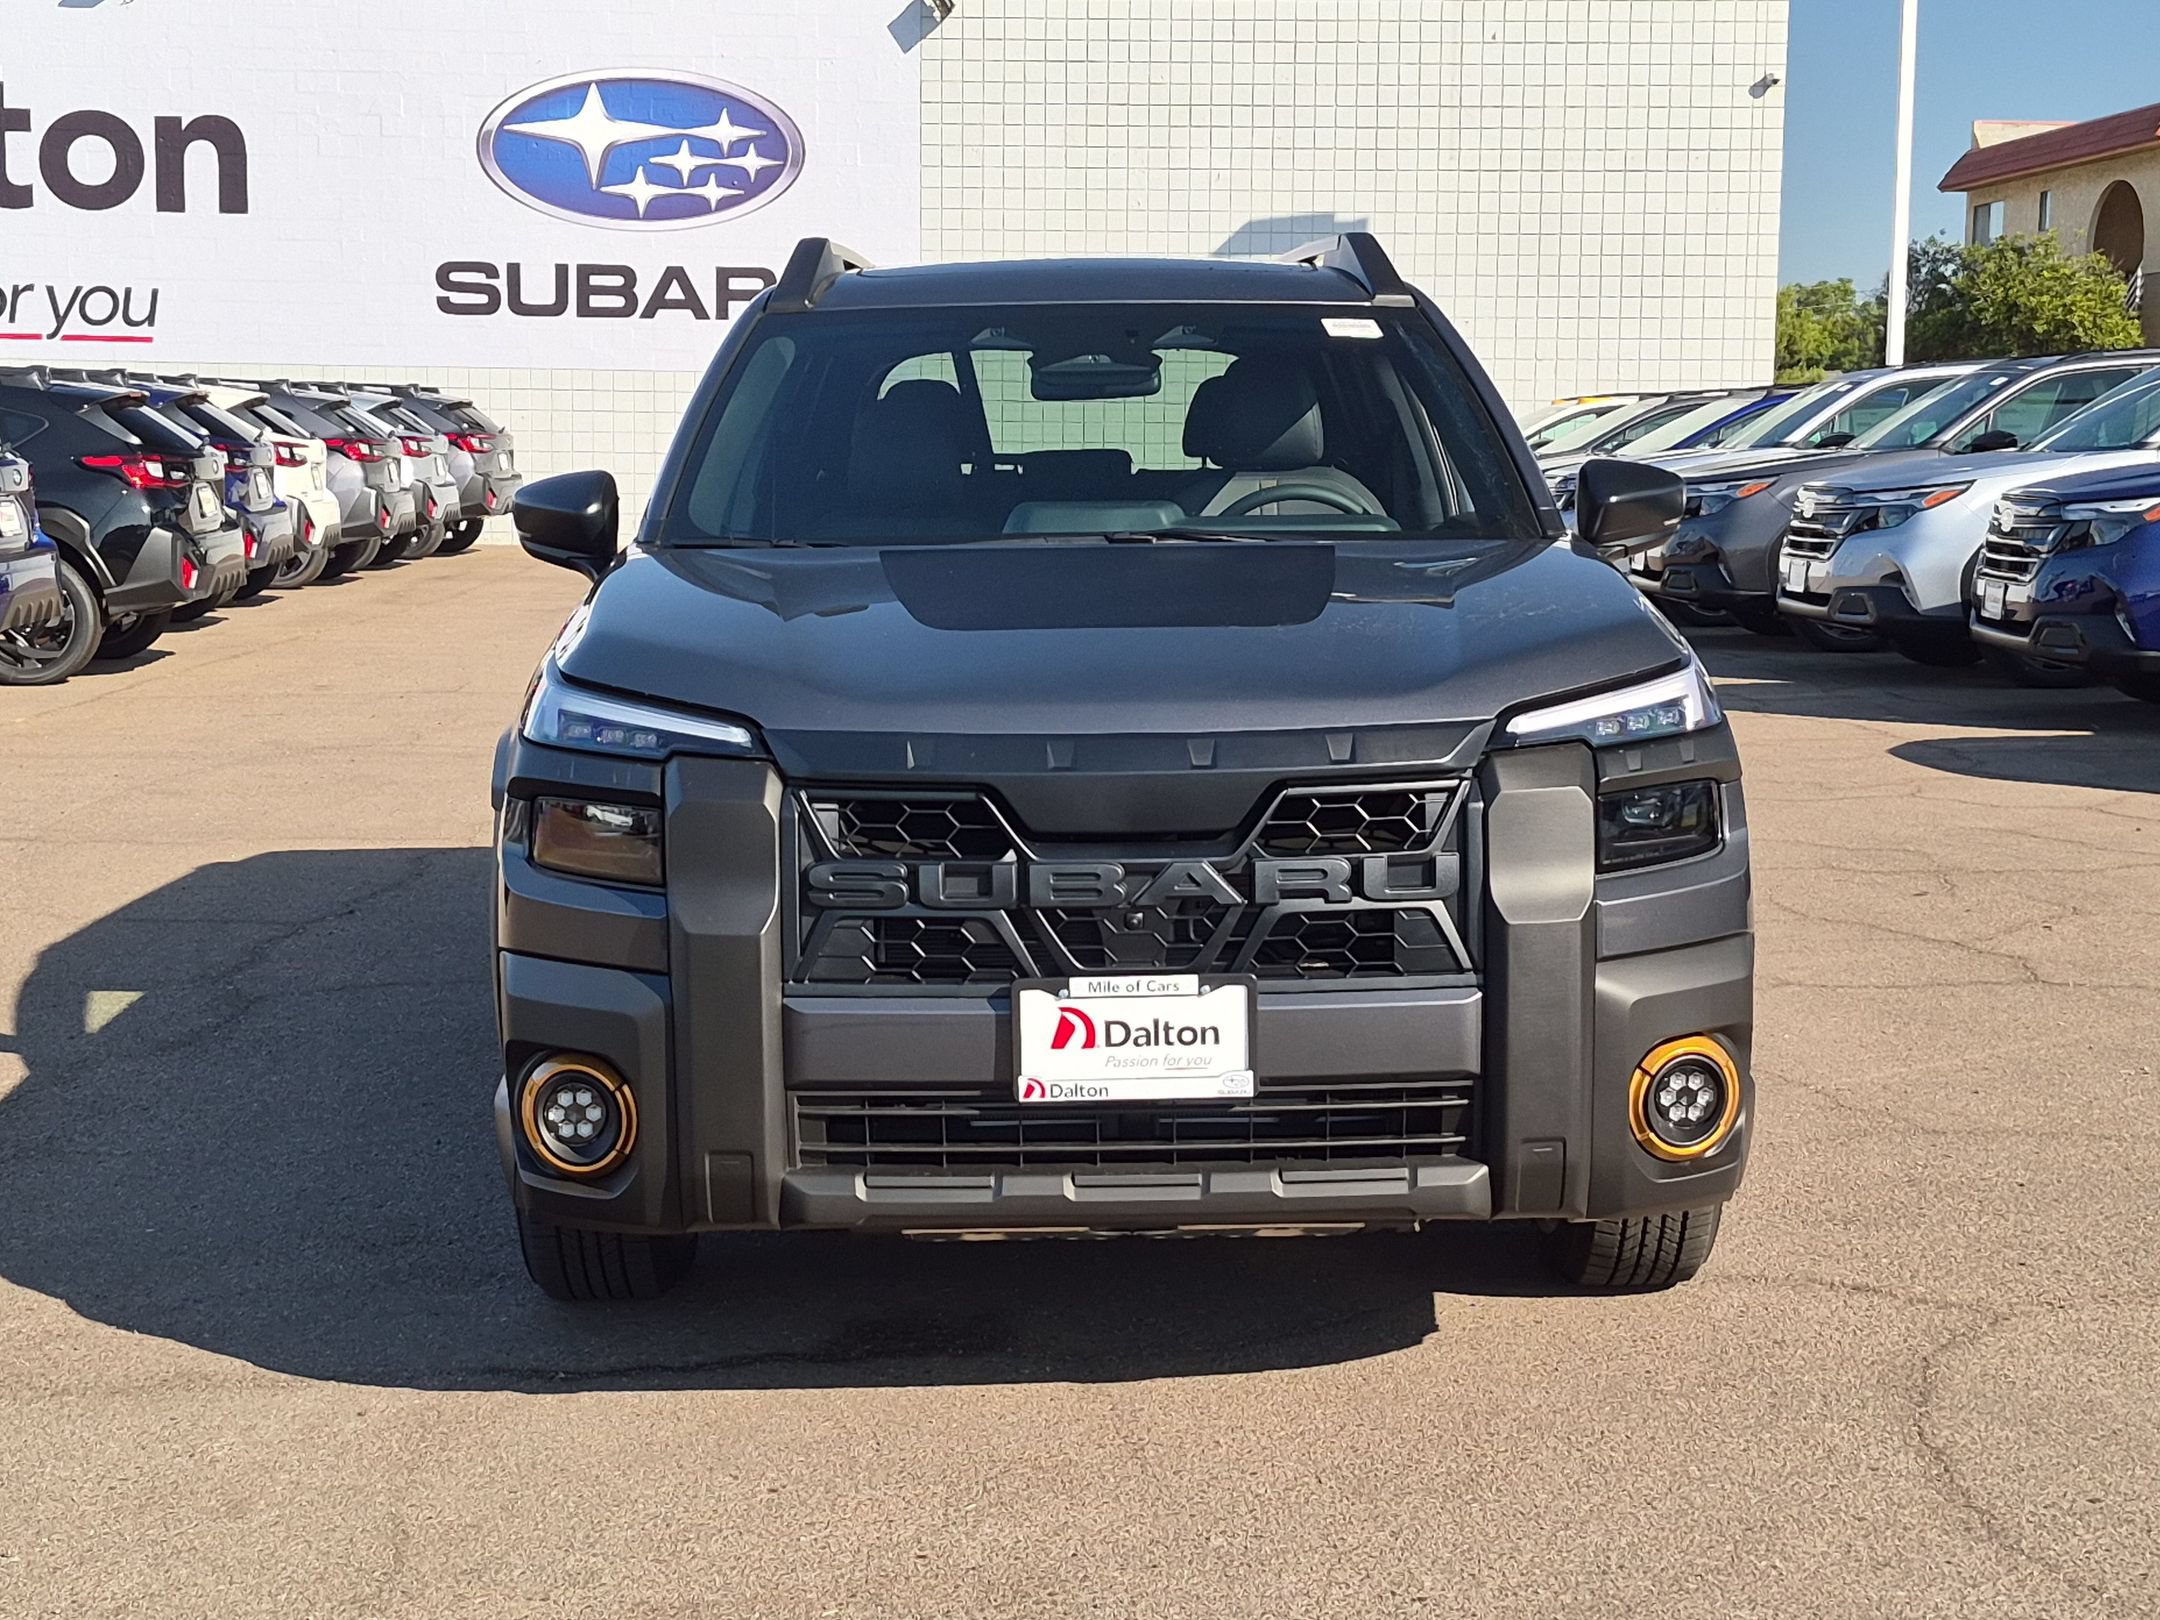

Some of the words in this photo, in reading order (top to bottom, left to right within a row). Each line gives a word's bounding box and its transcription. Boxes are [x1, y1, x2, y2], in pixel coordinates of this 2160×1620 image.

[45, 284, 160, 340] you
[807, 852, 1460, 907] SUBARU
[1088, 981, 1120, 993] Mile
[1125, 980, 1141, 993] of
[1146, 980, 1180, 992] Cars
[1104, 1018, 1221, 1048] Dalton
[1104, 1055, 1159, 1068] Passion
[1162, 1053, 1183, 1067] for
[1186, 1056, 1213, 1067] you
[1050, 1083, 1109, 1099] Dalton
